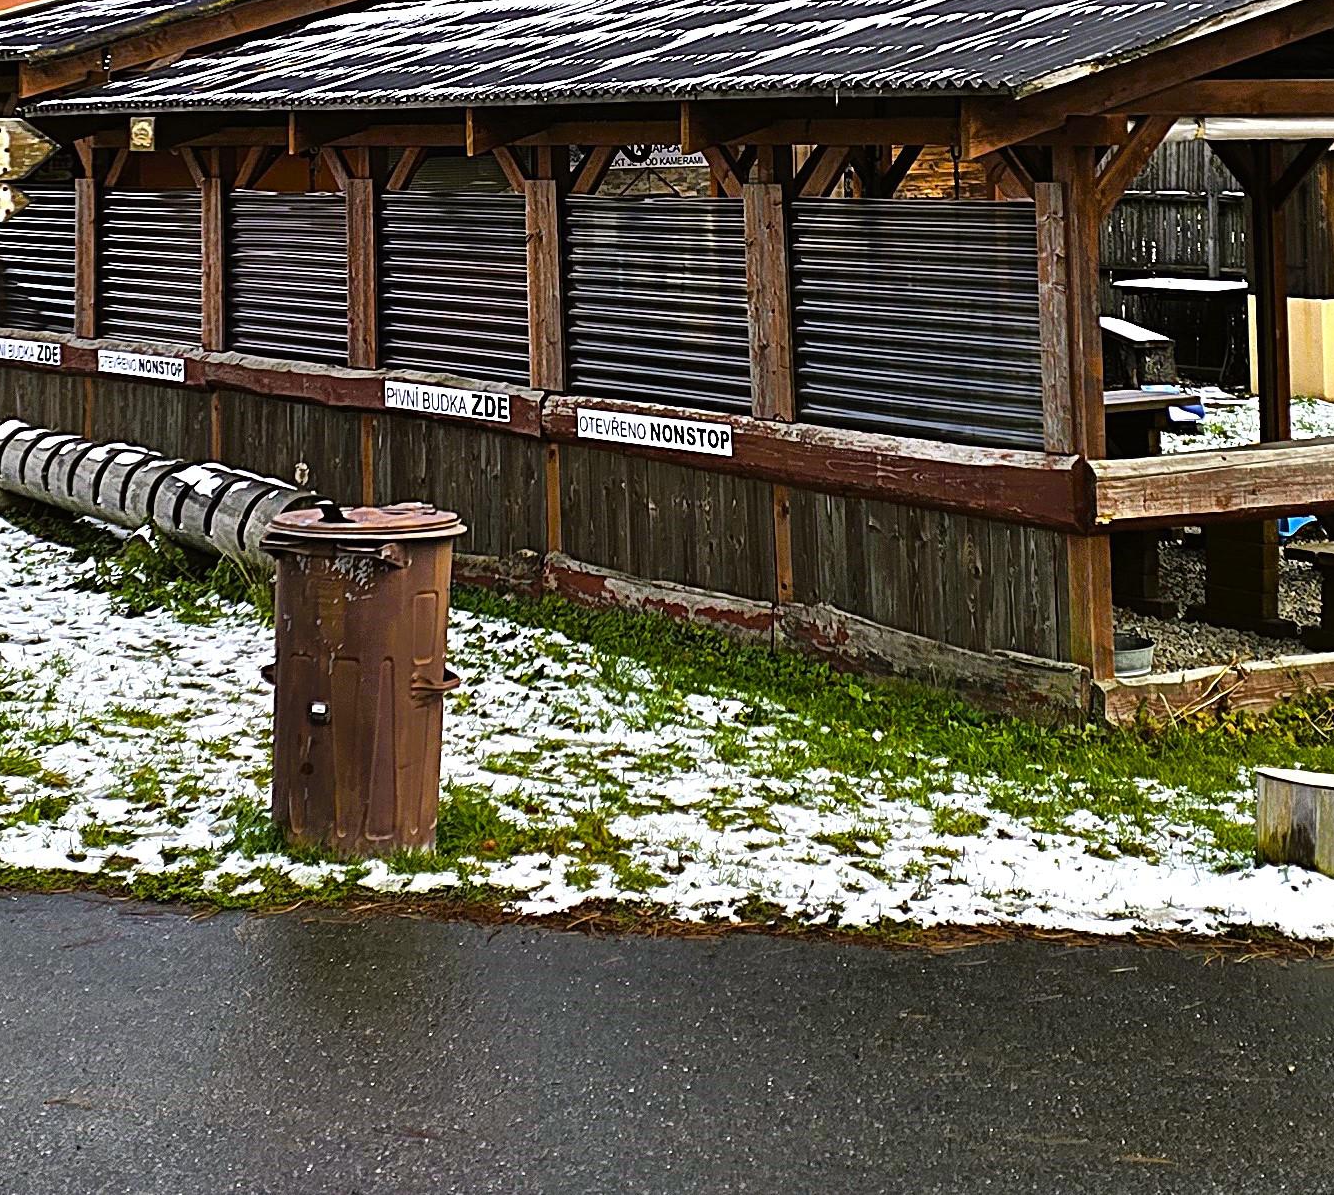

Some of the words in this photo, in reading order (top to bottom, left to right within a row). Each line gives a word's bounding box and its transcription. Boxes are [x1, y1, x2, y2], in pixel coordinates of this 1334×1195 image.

[659, 155, 704, 166] KAMERAMI
[37, 344, 60, 363] ZDE
[138, 358, 183, 378] NONSTOP
[386, 386, 419, 408] PIVNÍ
[423, 391, 467, 414] BUDKA
[471, 393, 508, 420] ZDE
[580, 415, 646, 440] OTEVŘENO
[650, 423, 731, 450] NONSTOP
